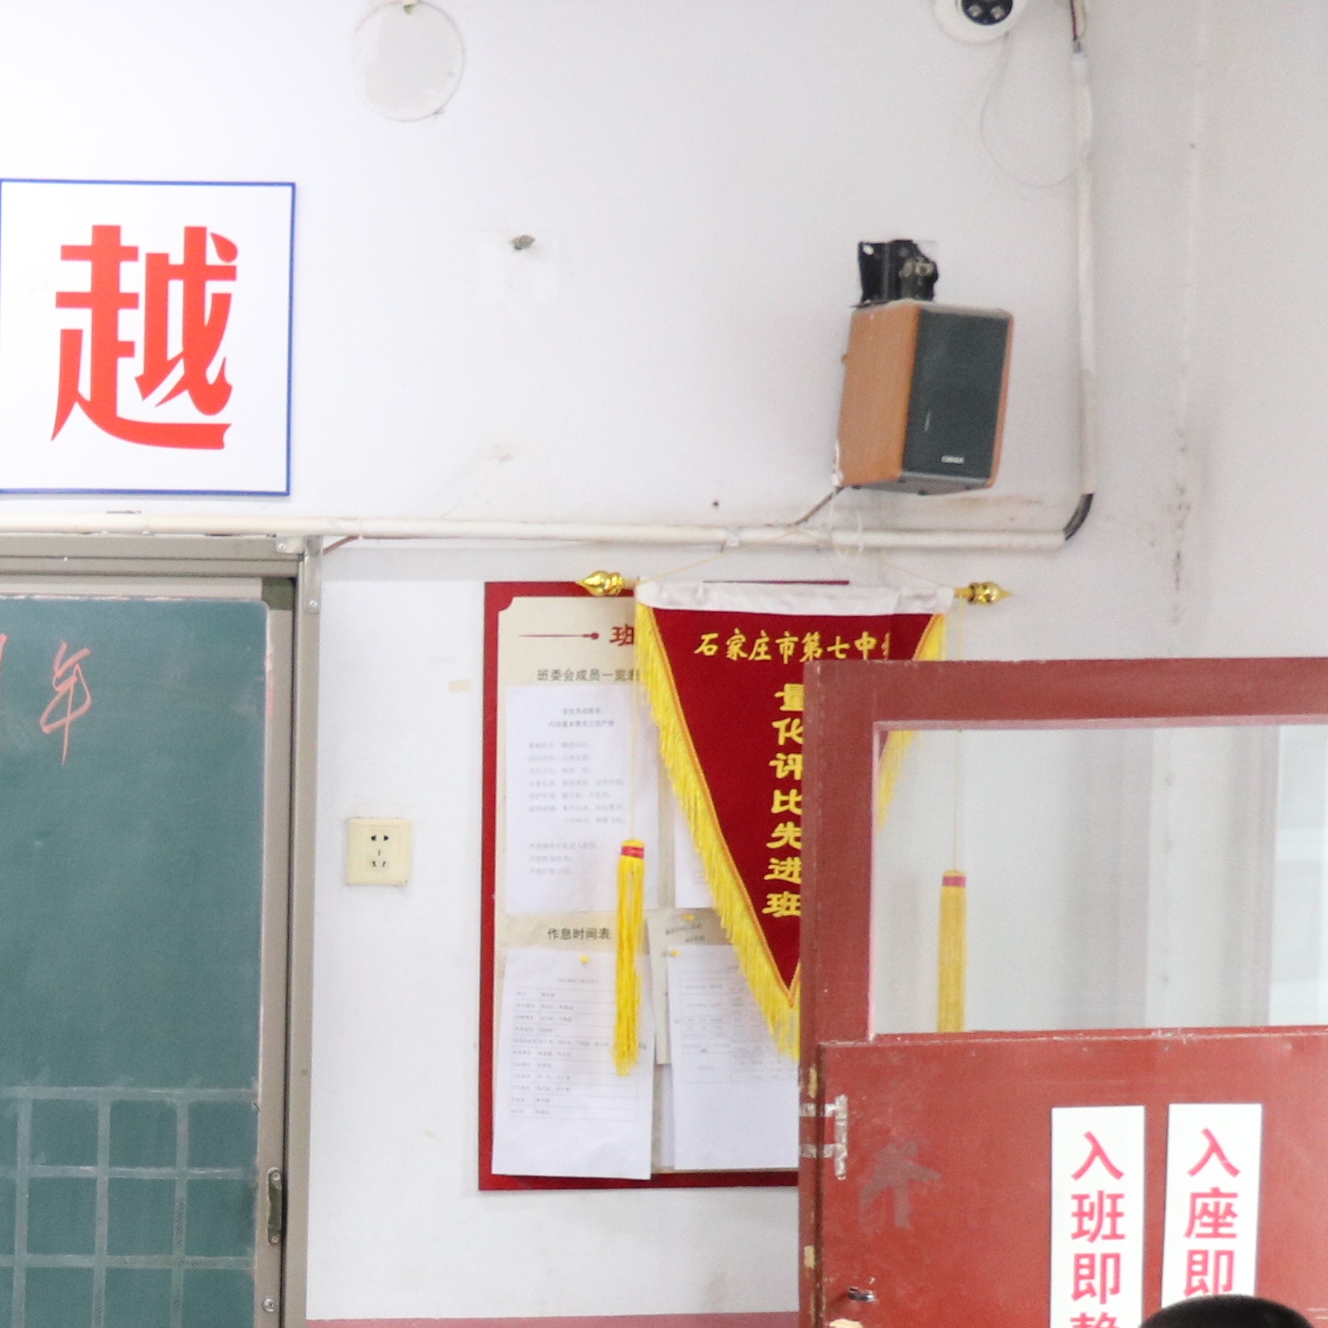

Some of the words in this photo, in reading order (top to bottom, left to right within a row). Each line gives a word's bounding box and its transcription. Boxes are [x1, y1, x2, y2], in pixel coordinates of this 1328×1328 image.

[762, 683, 804, 918] 量化评比先进班
[547, 927, 611, 941] 作息时间表
